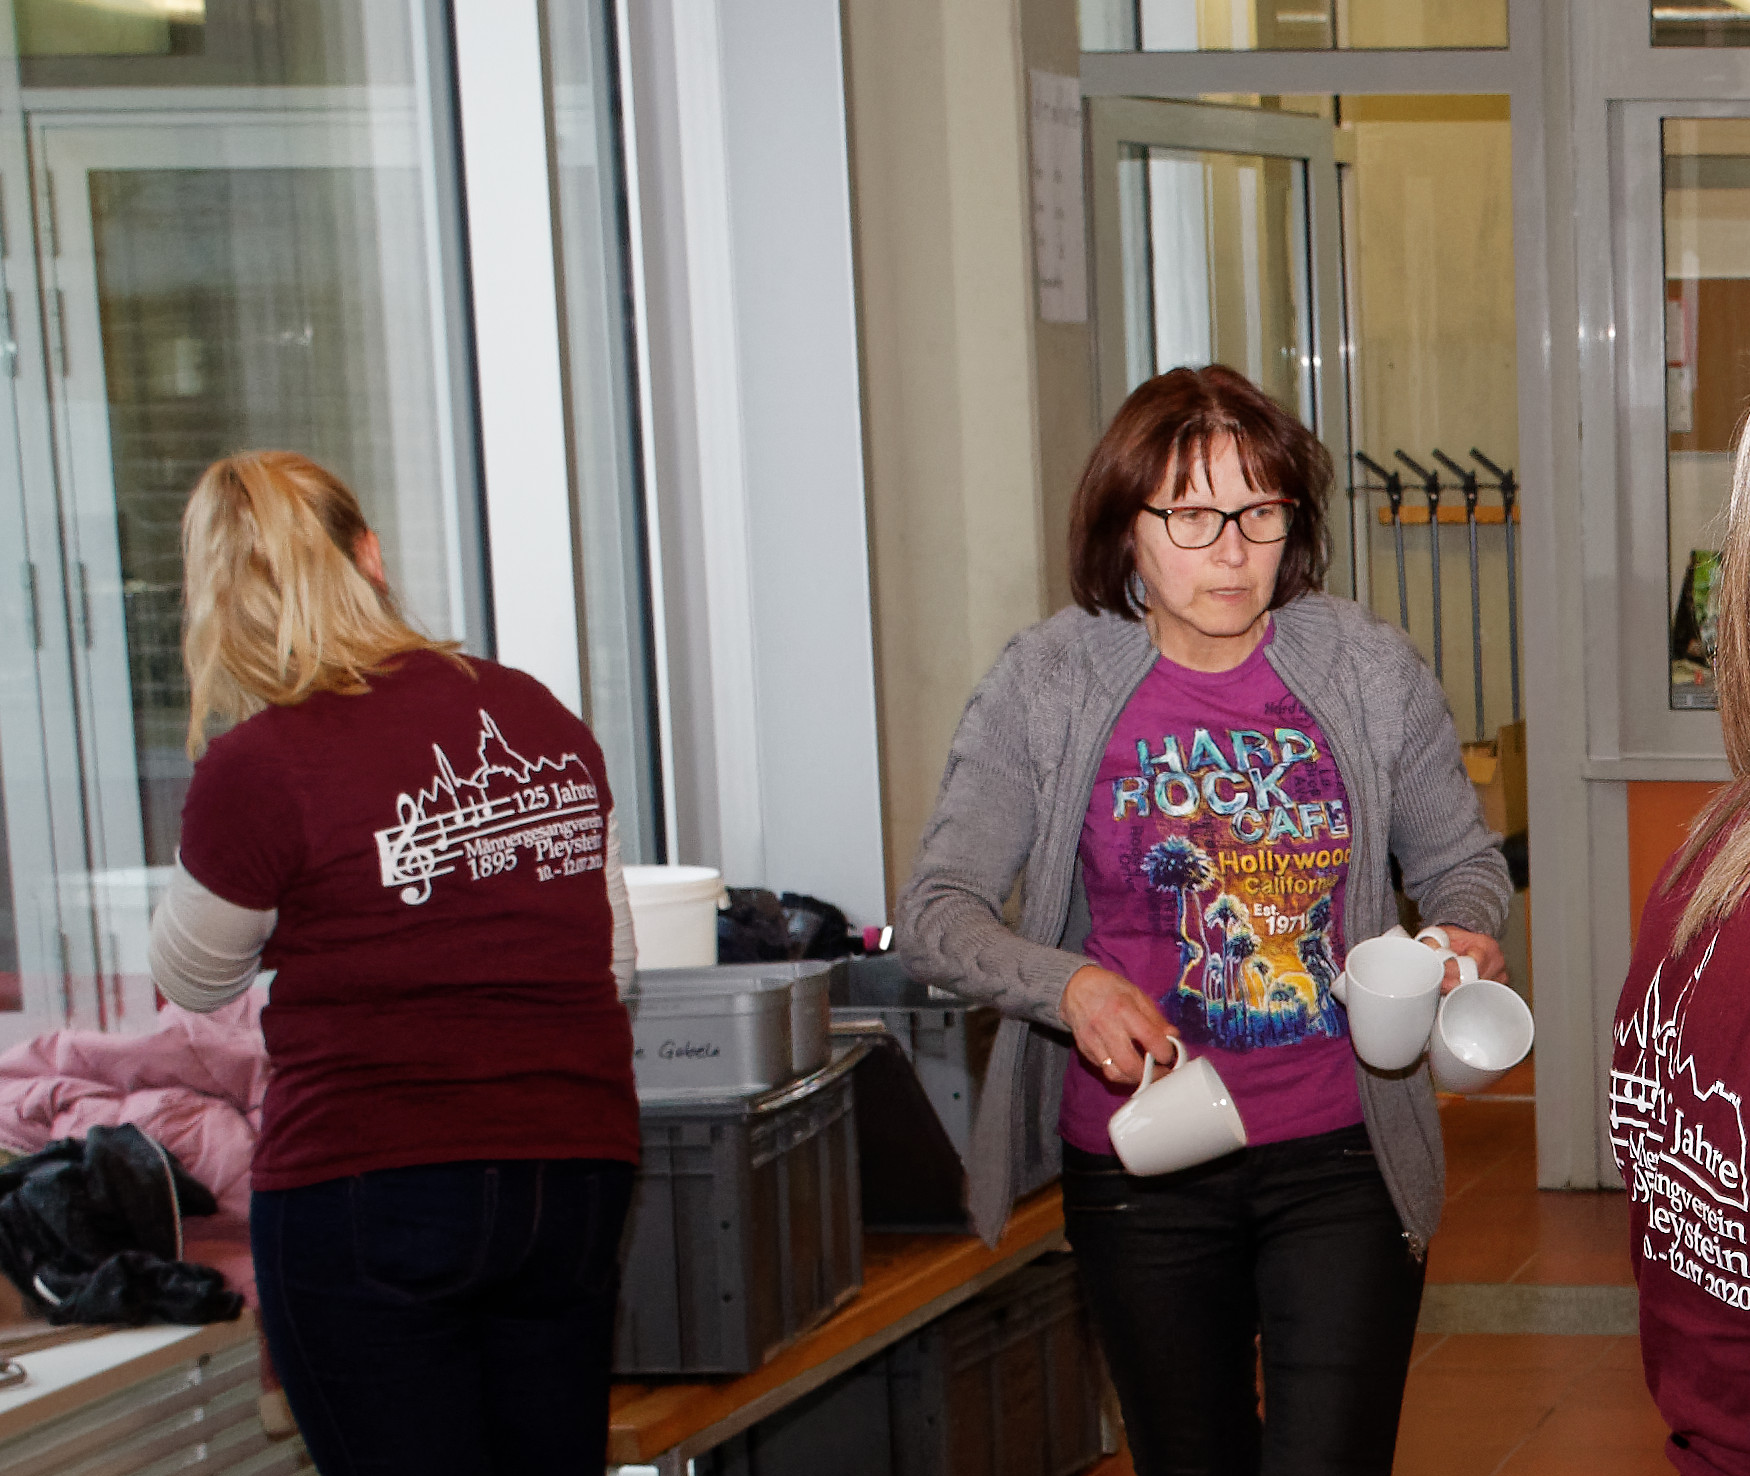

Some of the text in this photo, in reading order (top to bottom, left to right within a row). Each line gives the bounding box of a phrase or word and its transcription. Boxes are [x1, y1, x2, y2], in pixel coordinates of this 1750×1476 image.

[1135, 727, 1318, 776] HARD
[512, 779, 598, 814] 125 Jahre
[1113, 761, 1297, 820] ROCK
[1231, 799, 1350, 842] CAFE
[467, 847, 518, 881] 1895
[1253, 903, 1280, 917] Est.
[1669, 1108, 1740, 1189] Jahre
